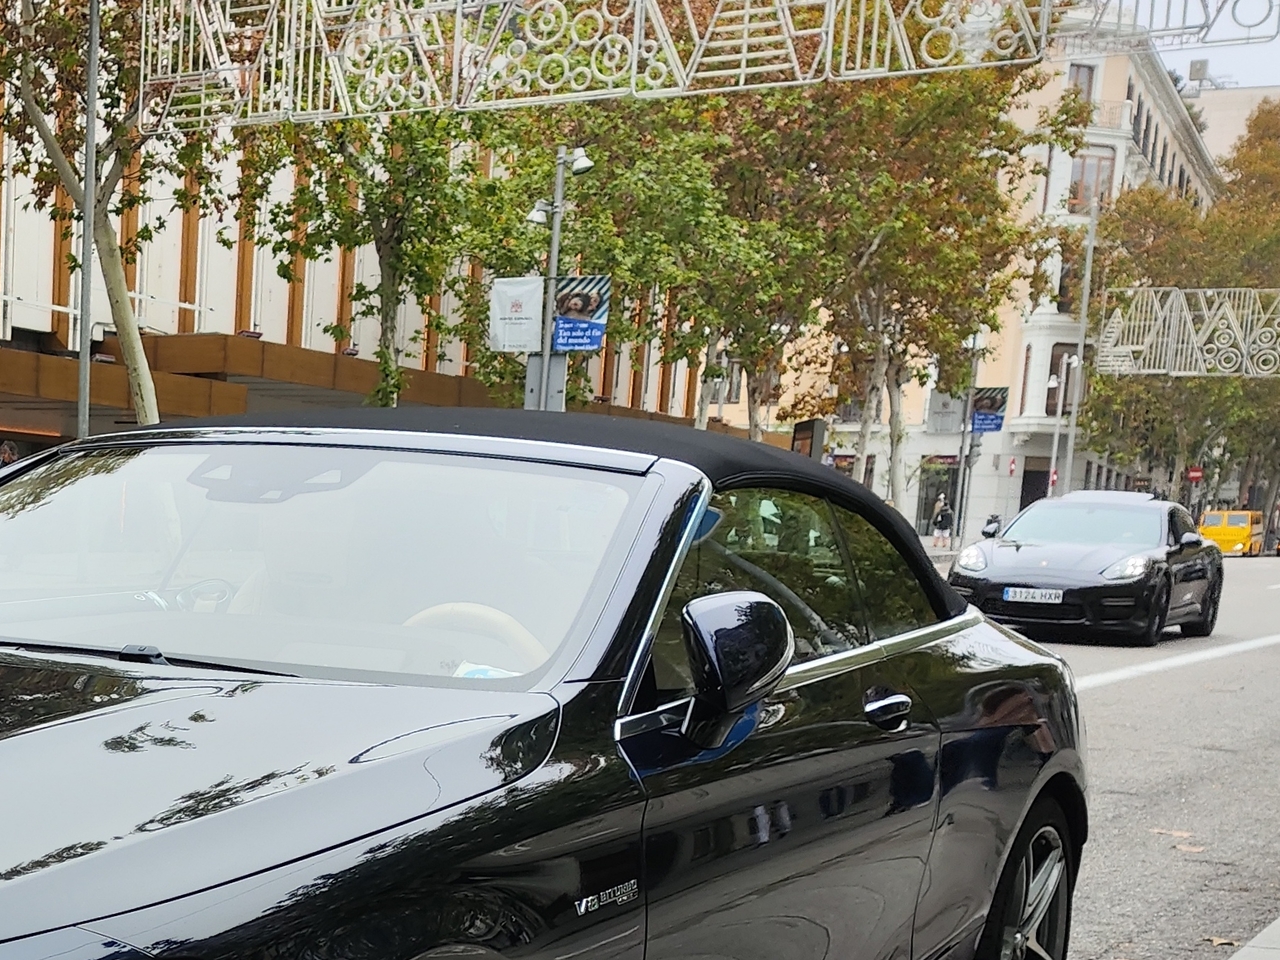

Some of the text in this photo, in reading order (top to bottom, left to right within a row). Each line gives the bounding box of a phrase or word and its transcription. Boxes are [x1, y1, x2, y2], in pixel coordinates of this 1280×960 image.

[1011, 588, 1061, 601] 3124 HXR
[574, 894, 599, 916] V8
[600, 879, 638, 902] BITURBO
